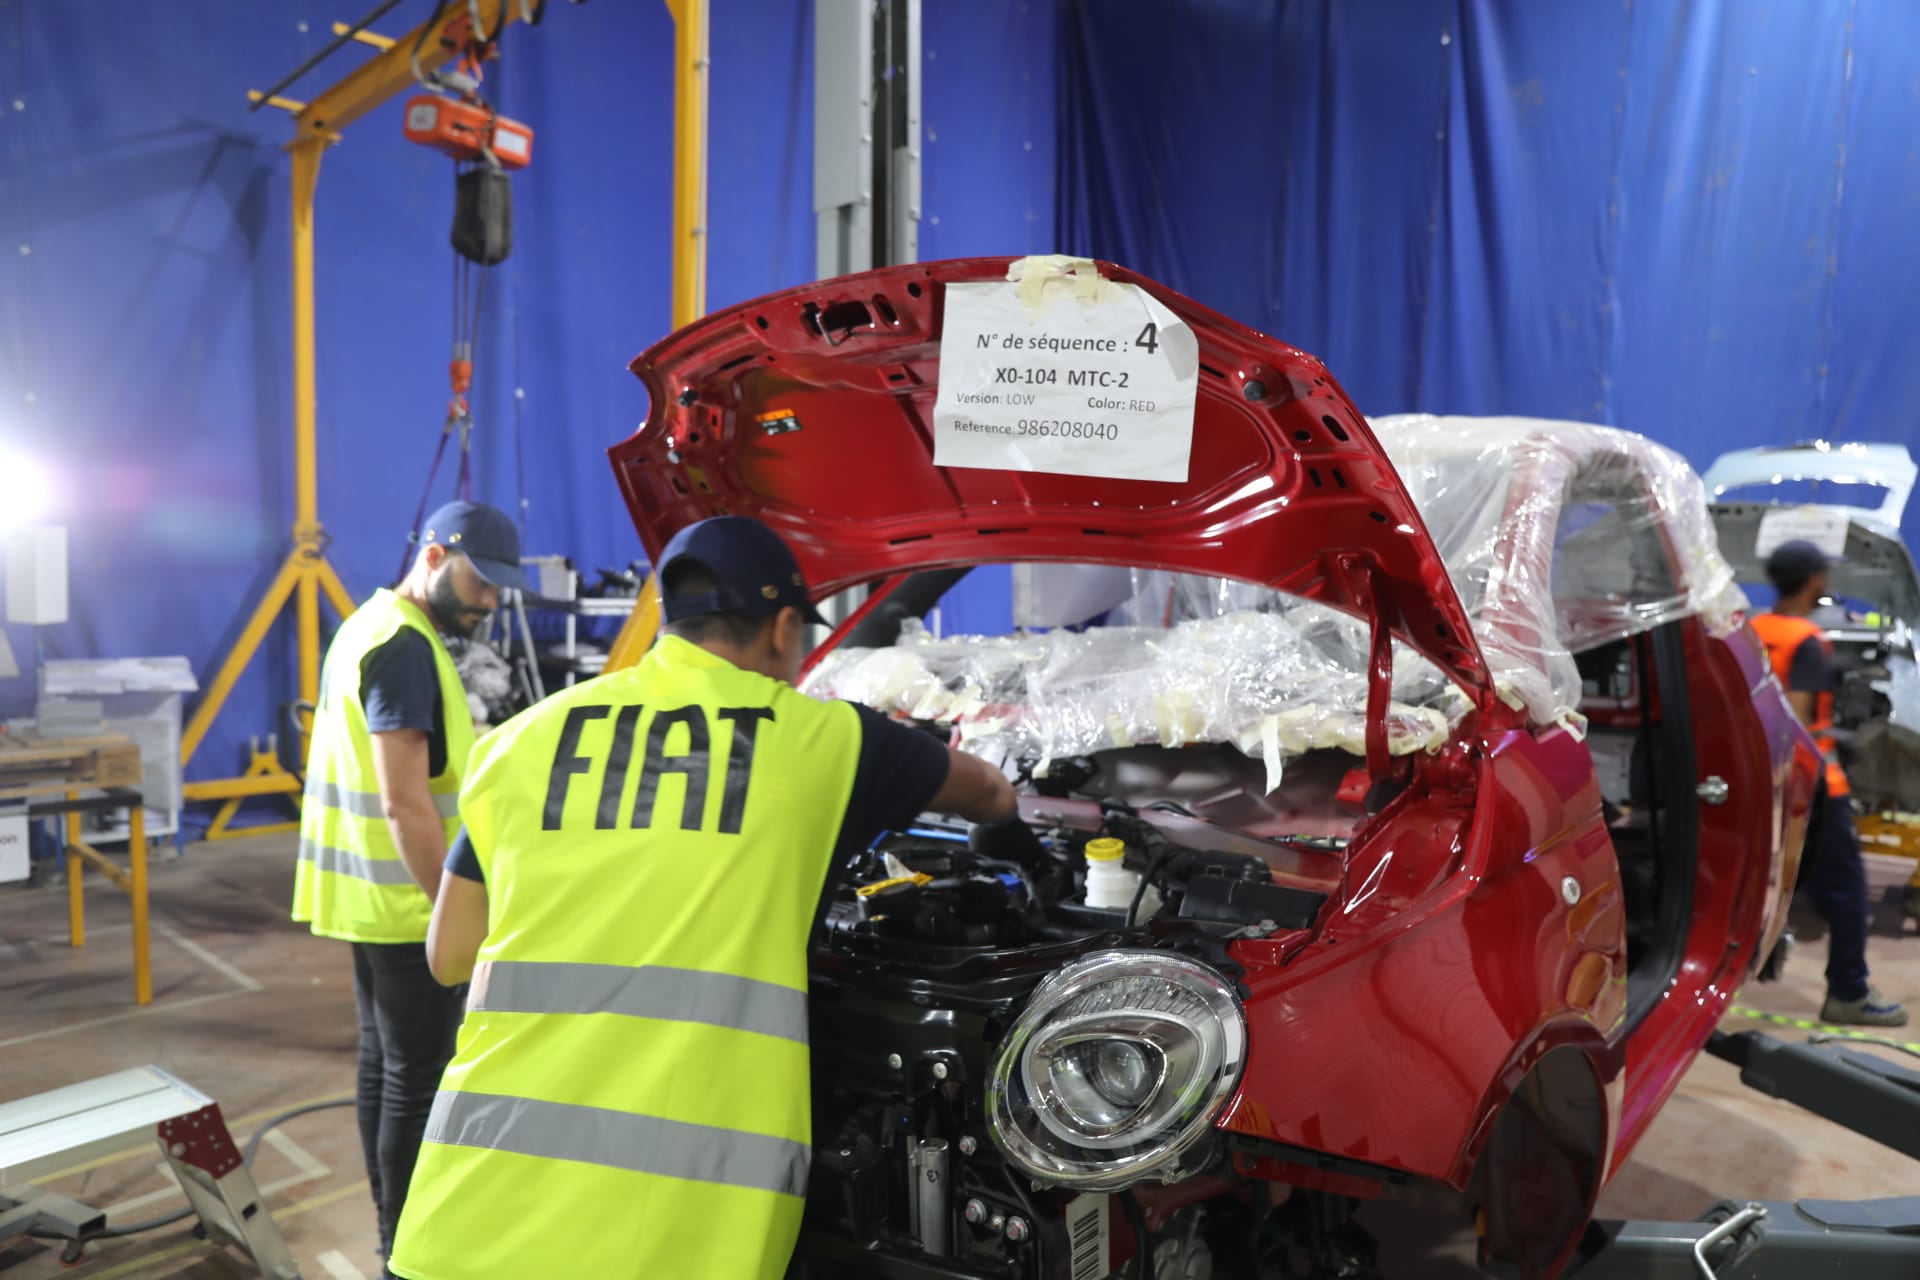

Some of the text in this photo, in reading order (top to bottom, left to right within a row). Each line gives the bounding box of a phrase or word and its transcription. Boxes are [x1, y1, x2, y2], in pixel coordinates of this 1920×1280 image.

[977, 333, 998, 349] N°
[1002, 334, 1024, 349] de
[1028, 333, 1116, 353] séquence
[1135, 322, 1159, 354] 4
[1068, 370, 1129, 388] MTC-2
[957, 393, 1036, 406] Version: LOW
[1088, 397, 1155, 412] Color: RED
[1017, 419, 1118, 440] 986208040
[542, 704, 776, 835] FIAT
